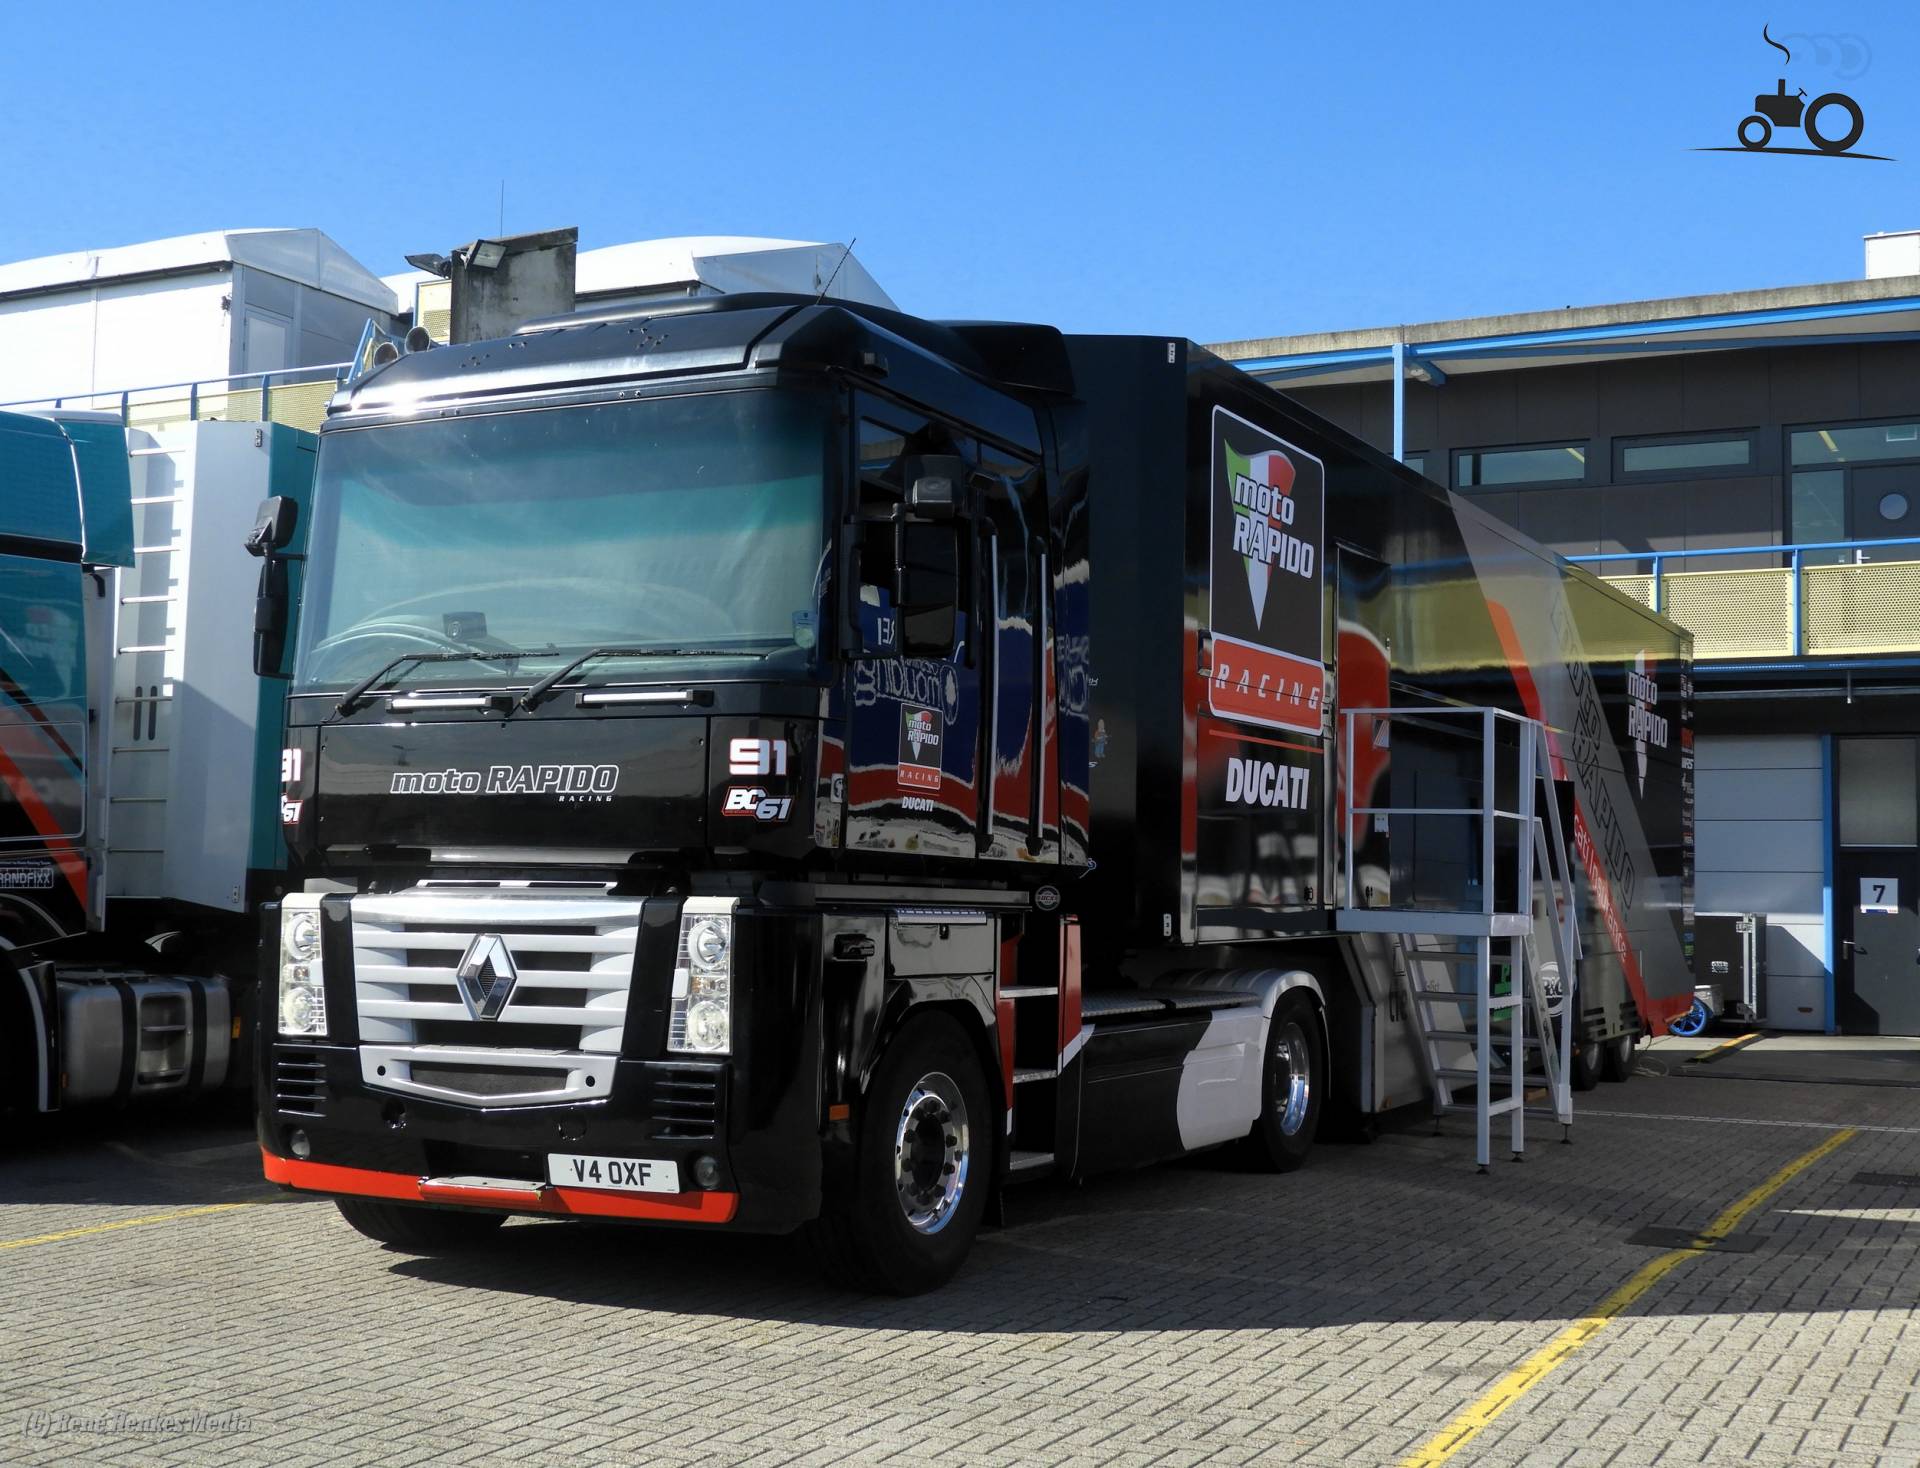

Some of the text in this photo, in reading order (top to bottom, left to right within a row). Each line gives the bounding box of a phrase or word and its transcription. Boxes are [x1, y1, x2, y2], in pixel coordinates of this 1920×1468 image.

[1233, 473, 1295, 526] moto
[1232, 513, 1315, 579] RAPIDO
[1216, 663, 1320, 710] RACING
[1628, 671, 1658, 706] moto
[907, 719, 932, 732] moto
[907, 730, 939, 746] RAPIDO
[1628, 705, 1668, 749] RAPIDO
[729, 738, 787, 775] 91
[390, 765, 619, 794] moto RAPIDO
[900, 769, 939, 783] RACING
[1225, 756, 1311, 811] DUCATI
[281, 795, 303, 823] 61
[559, 795, 613, 803] RACING
[902, 796, 935, 812] DUCATI
[1872, 884, 1886, 903] 7
[573, 1158, 651, 1186] V4 OXF
